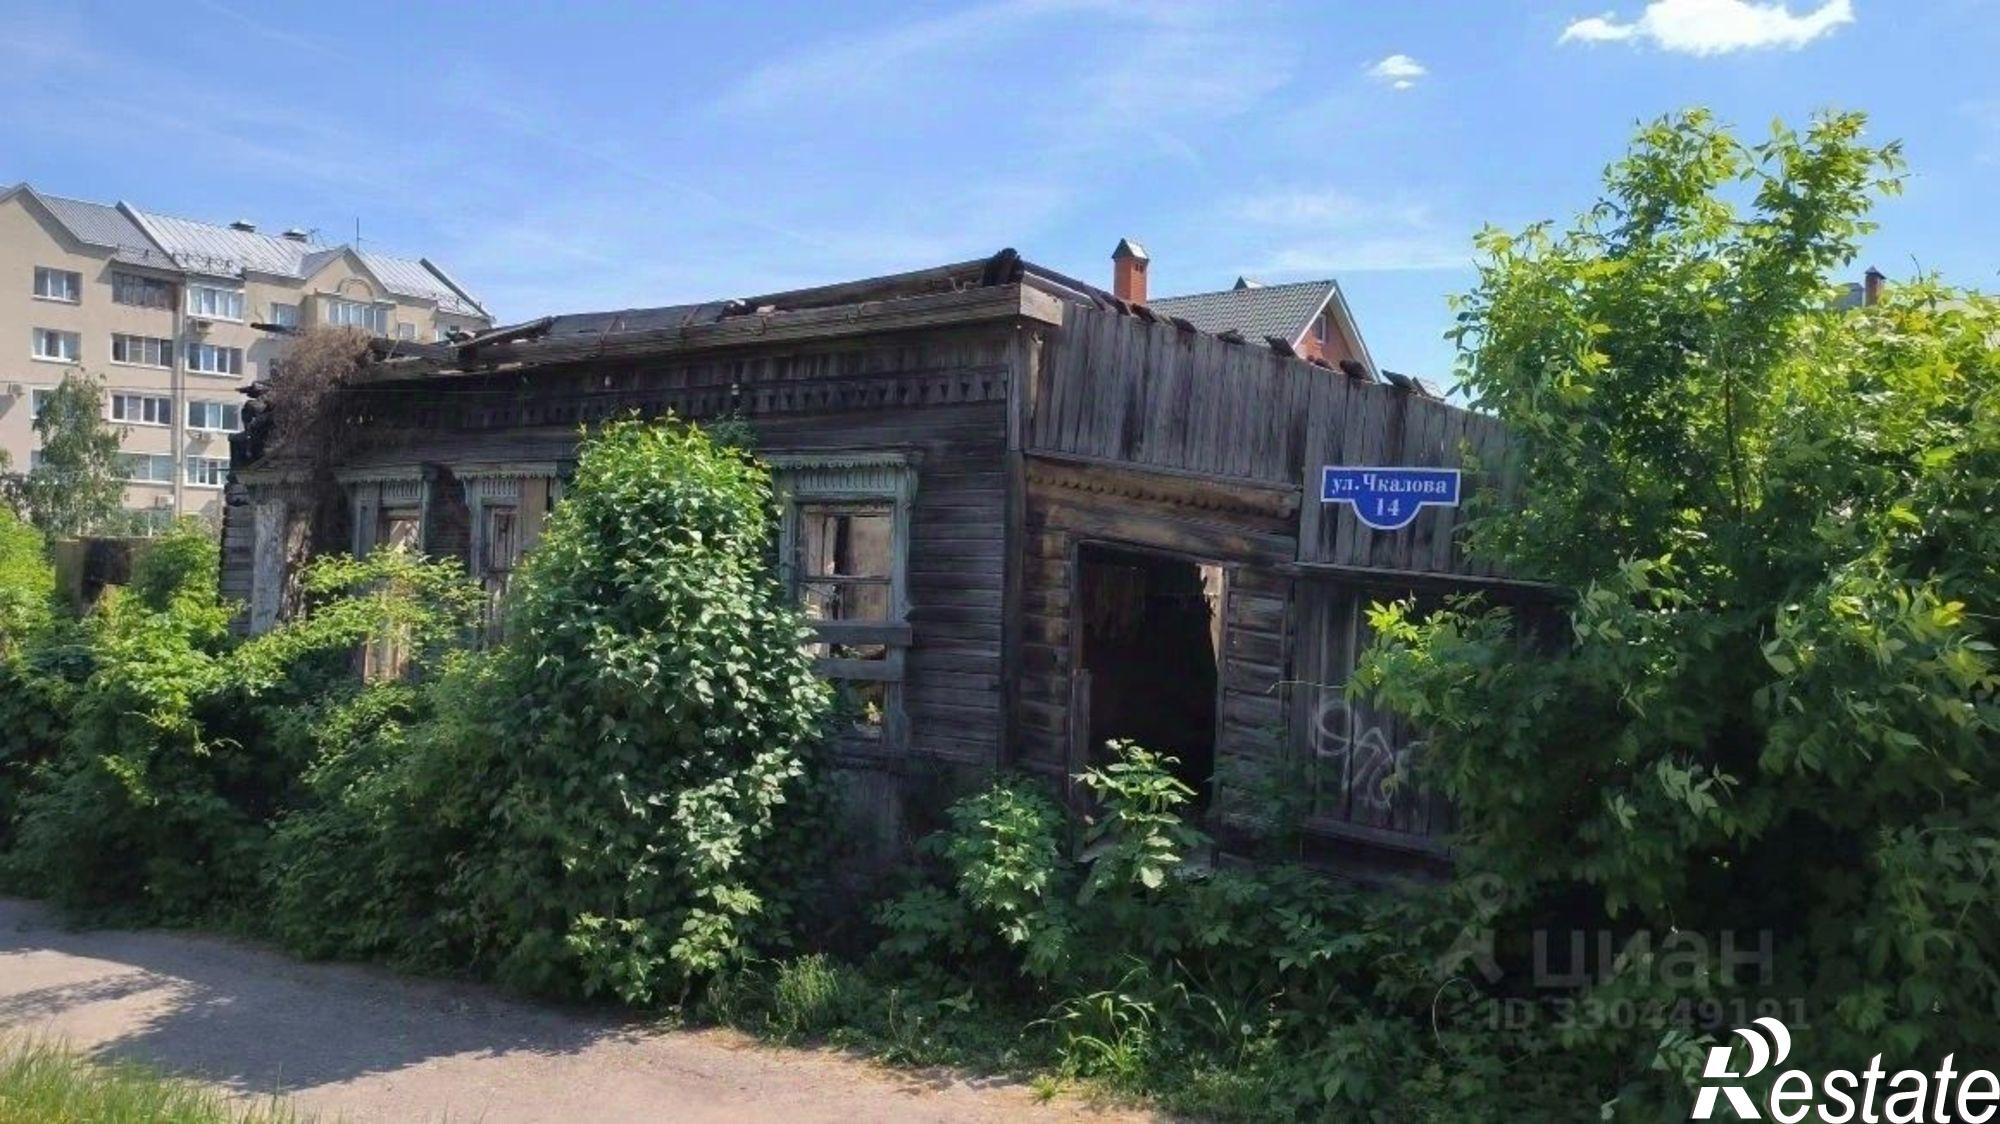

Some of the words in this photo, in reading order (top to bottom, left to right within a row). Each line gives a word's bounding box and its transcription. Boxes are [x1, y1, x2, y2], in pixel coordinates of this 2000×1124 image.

[1331, 477, 1360, 494] ул.
[1362, 473, 1447, 494] Чкалова
[1376, 498, 1400, 516] 14
